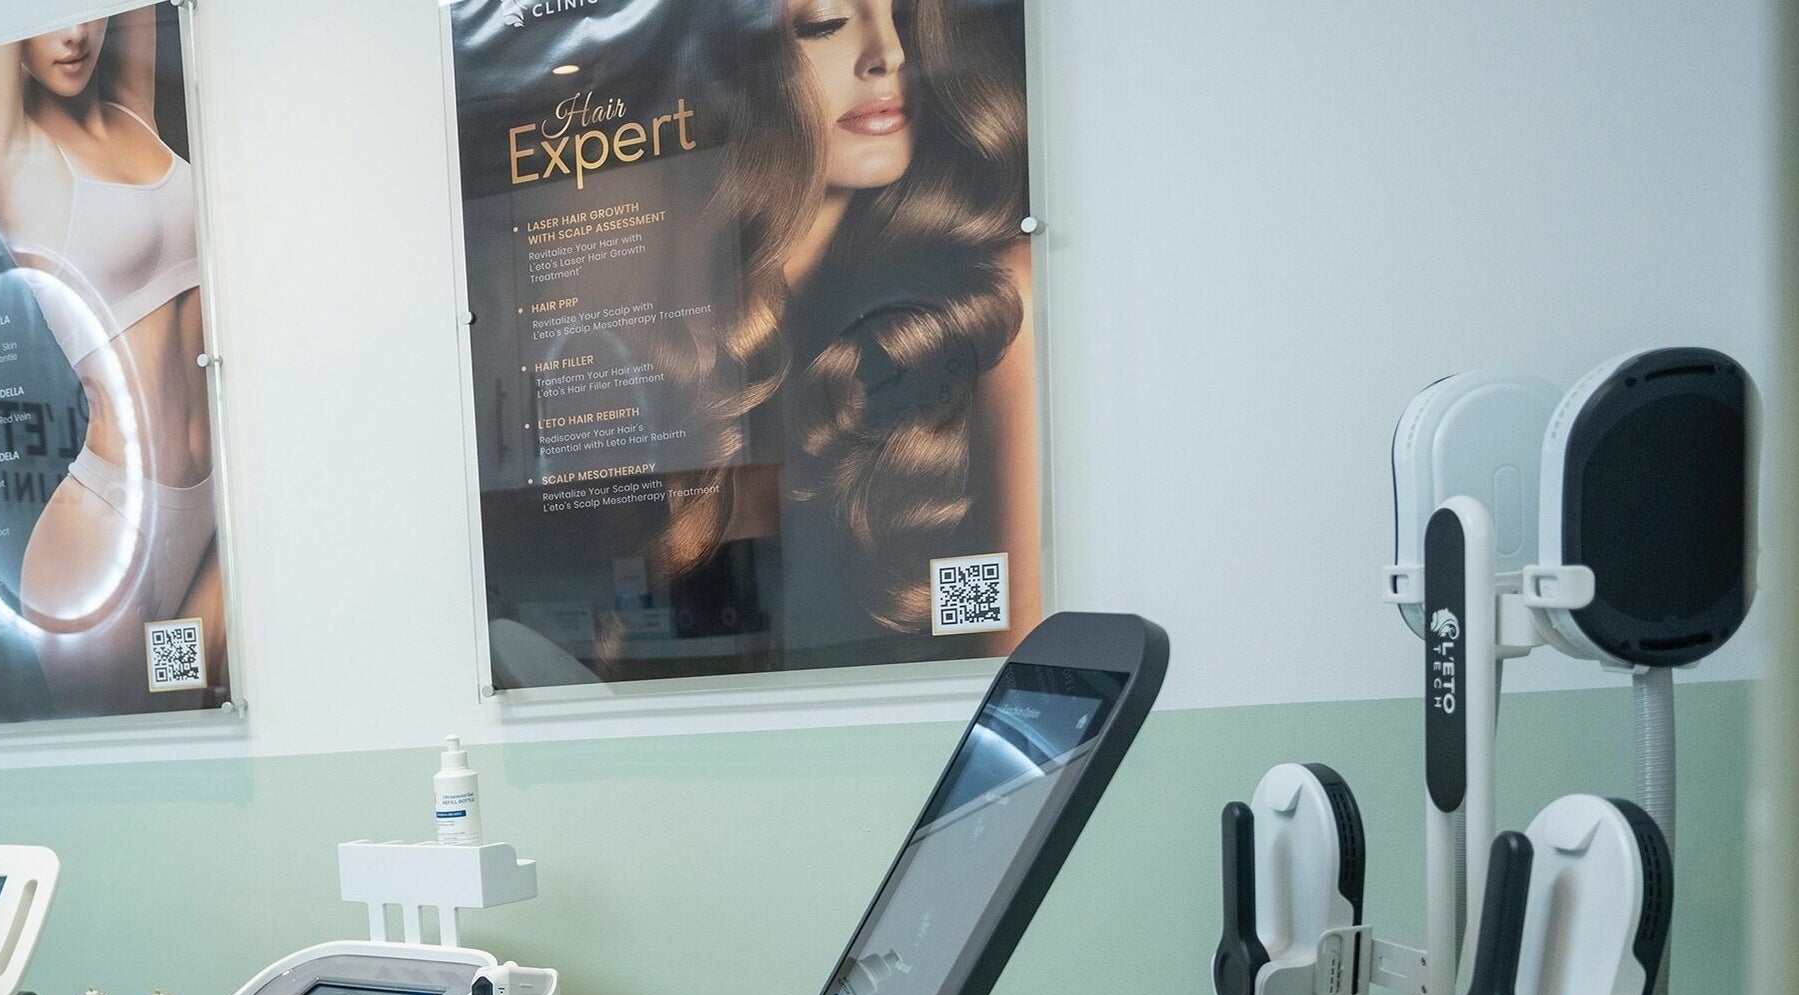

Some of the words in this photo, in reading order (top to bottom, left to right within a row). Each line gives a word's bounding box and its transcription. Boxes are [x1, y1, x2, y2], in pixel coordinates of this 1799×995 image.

[532, 0, 598, 17] CLINI
[542, 91, 626, 139] Hair
[509, 99, 697, 189] Expert
[528, 218, 558, 232] LASER
[562, 213, 586, 225] HAIR
[590, 203, 639, 220] GROWTH
[528, 233, 555, 245] WITH
[559, 225, 592, 240] SCALP
[595, 211, 666, 233] ASSESSMENT
[529, 245, 572, 261] Revitalize
[575, 242, 596, 252] Your
[600, 238, 618, 248] Hair
[622, 233, 642, 243] with
[560, 256, 585, 267] Laser
[588, 251, 607, 262] Hair
[610, 245, 645, 257] Growth
[531, 301, 556, 313] HAIR
[559, 298, 578, 309] PRP
[533, 315, 576, 329] Revitalize
[579, 309, 600, 320] Your
[603, 303, 630, 317] Scalp
[633, 302, 653, 312] with
[564, 324, 590, 336] Scalp
[593, 313, 656, 330] Mesotherapy
[659, 304, 711, 319] Treatment
[2, 342, 18, 352] Skin
[535, 360, 559, 372] HAIR
[562, 356, 593, 368] FILLER
[537, 373, 584, 387] Transform
[587, 370, 608, 380] Your
[611, 367, 629, 376] Hair
[633, 363, 653, 373] with
[568, 384, 586, 393] Hair
[589, 380, 611, 390] Filler
[614, 373, 664, 387] Treatment
[14, 412, 32, 422] Vein
[569, 413, 593, 424] HAIR
[597, 407, 639, 421] REBIRTH
[540, 431, 590, 444] Rediscover
[593, 427, 614, 437] Your
[540, 443, 581, 455] Potential
[584, 440, 604, 449] with
[629, 434, 648, 444] Hair
[651, 429, 686, 441] Rebirth
[542, 472, 575, 485] SCALP
[578, 463, 656, 481] MESOTHERAPY
[543, 489, 586, 501] Revitalize
[589, 485, 609, 495] Your
[613, 482, 639, 494] Scalp
[642, 480, 662, 489] with
[574, 497, 600, 509] Scalp
[603, 491, 665, 506] Mesotherapy
[668, 484, 720, 498] Treatment
[1433, 644, 1442, 708] TECH
[1442, 642, 1456, 714] L'ETO
